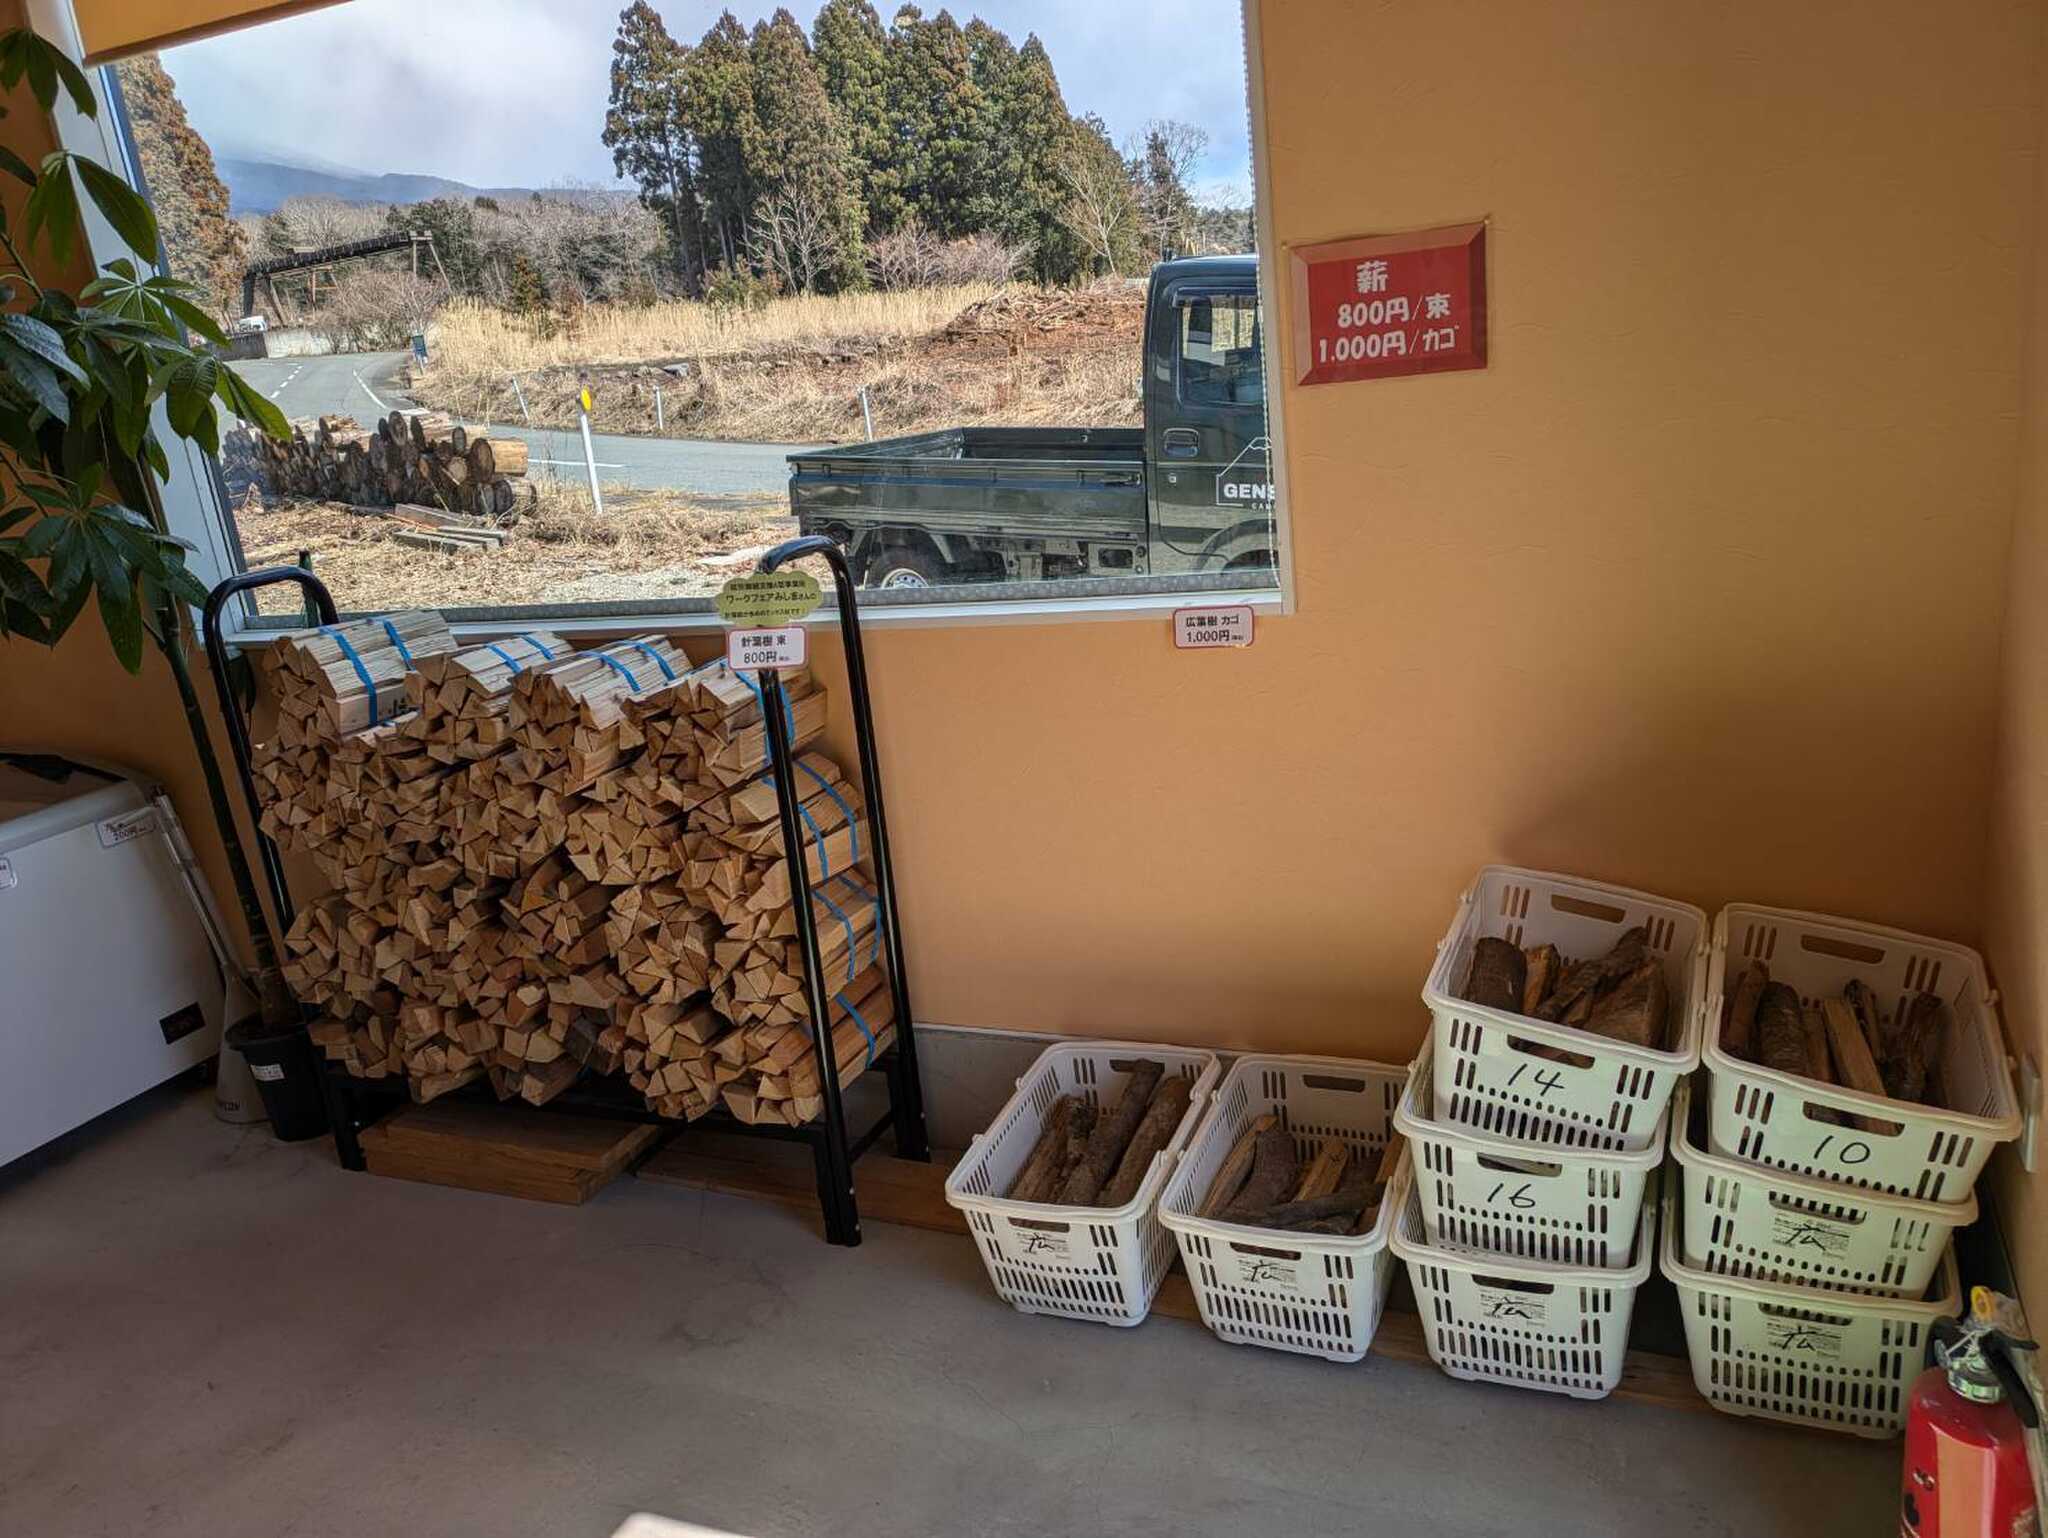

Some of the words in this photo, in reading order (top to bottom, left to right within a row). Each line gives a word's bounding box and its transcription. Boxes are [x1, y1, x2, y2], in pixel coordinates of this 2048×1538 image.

[1356, 260, 1389, 294] 薪
[1221, 613, 1239, 625] カゴ
[1186, 630, 1230, 643] 1,000円
[743, 651, 777, 664] 800円
[1507, 1063, 1565, 1096] 14
[1813, 1135, 1871, 1164] 10
[1487, 1183, 1536, 1209] 16
